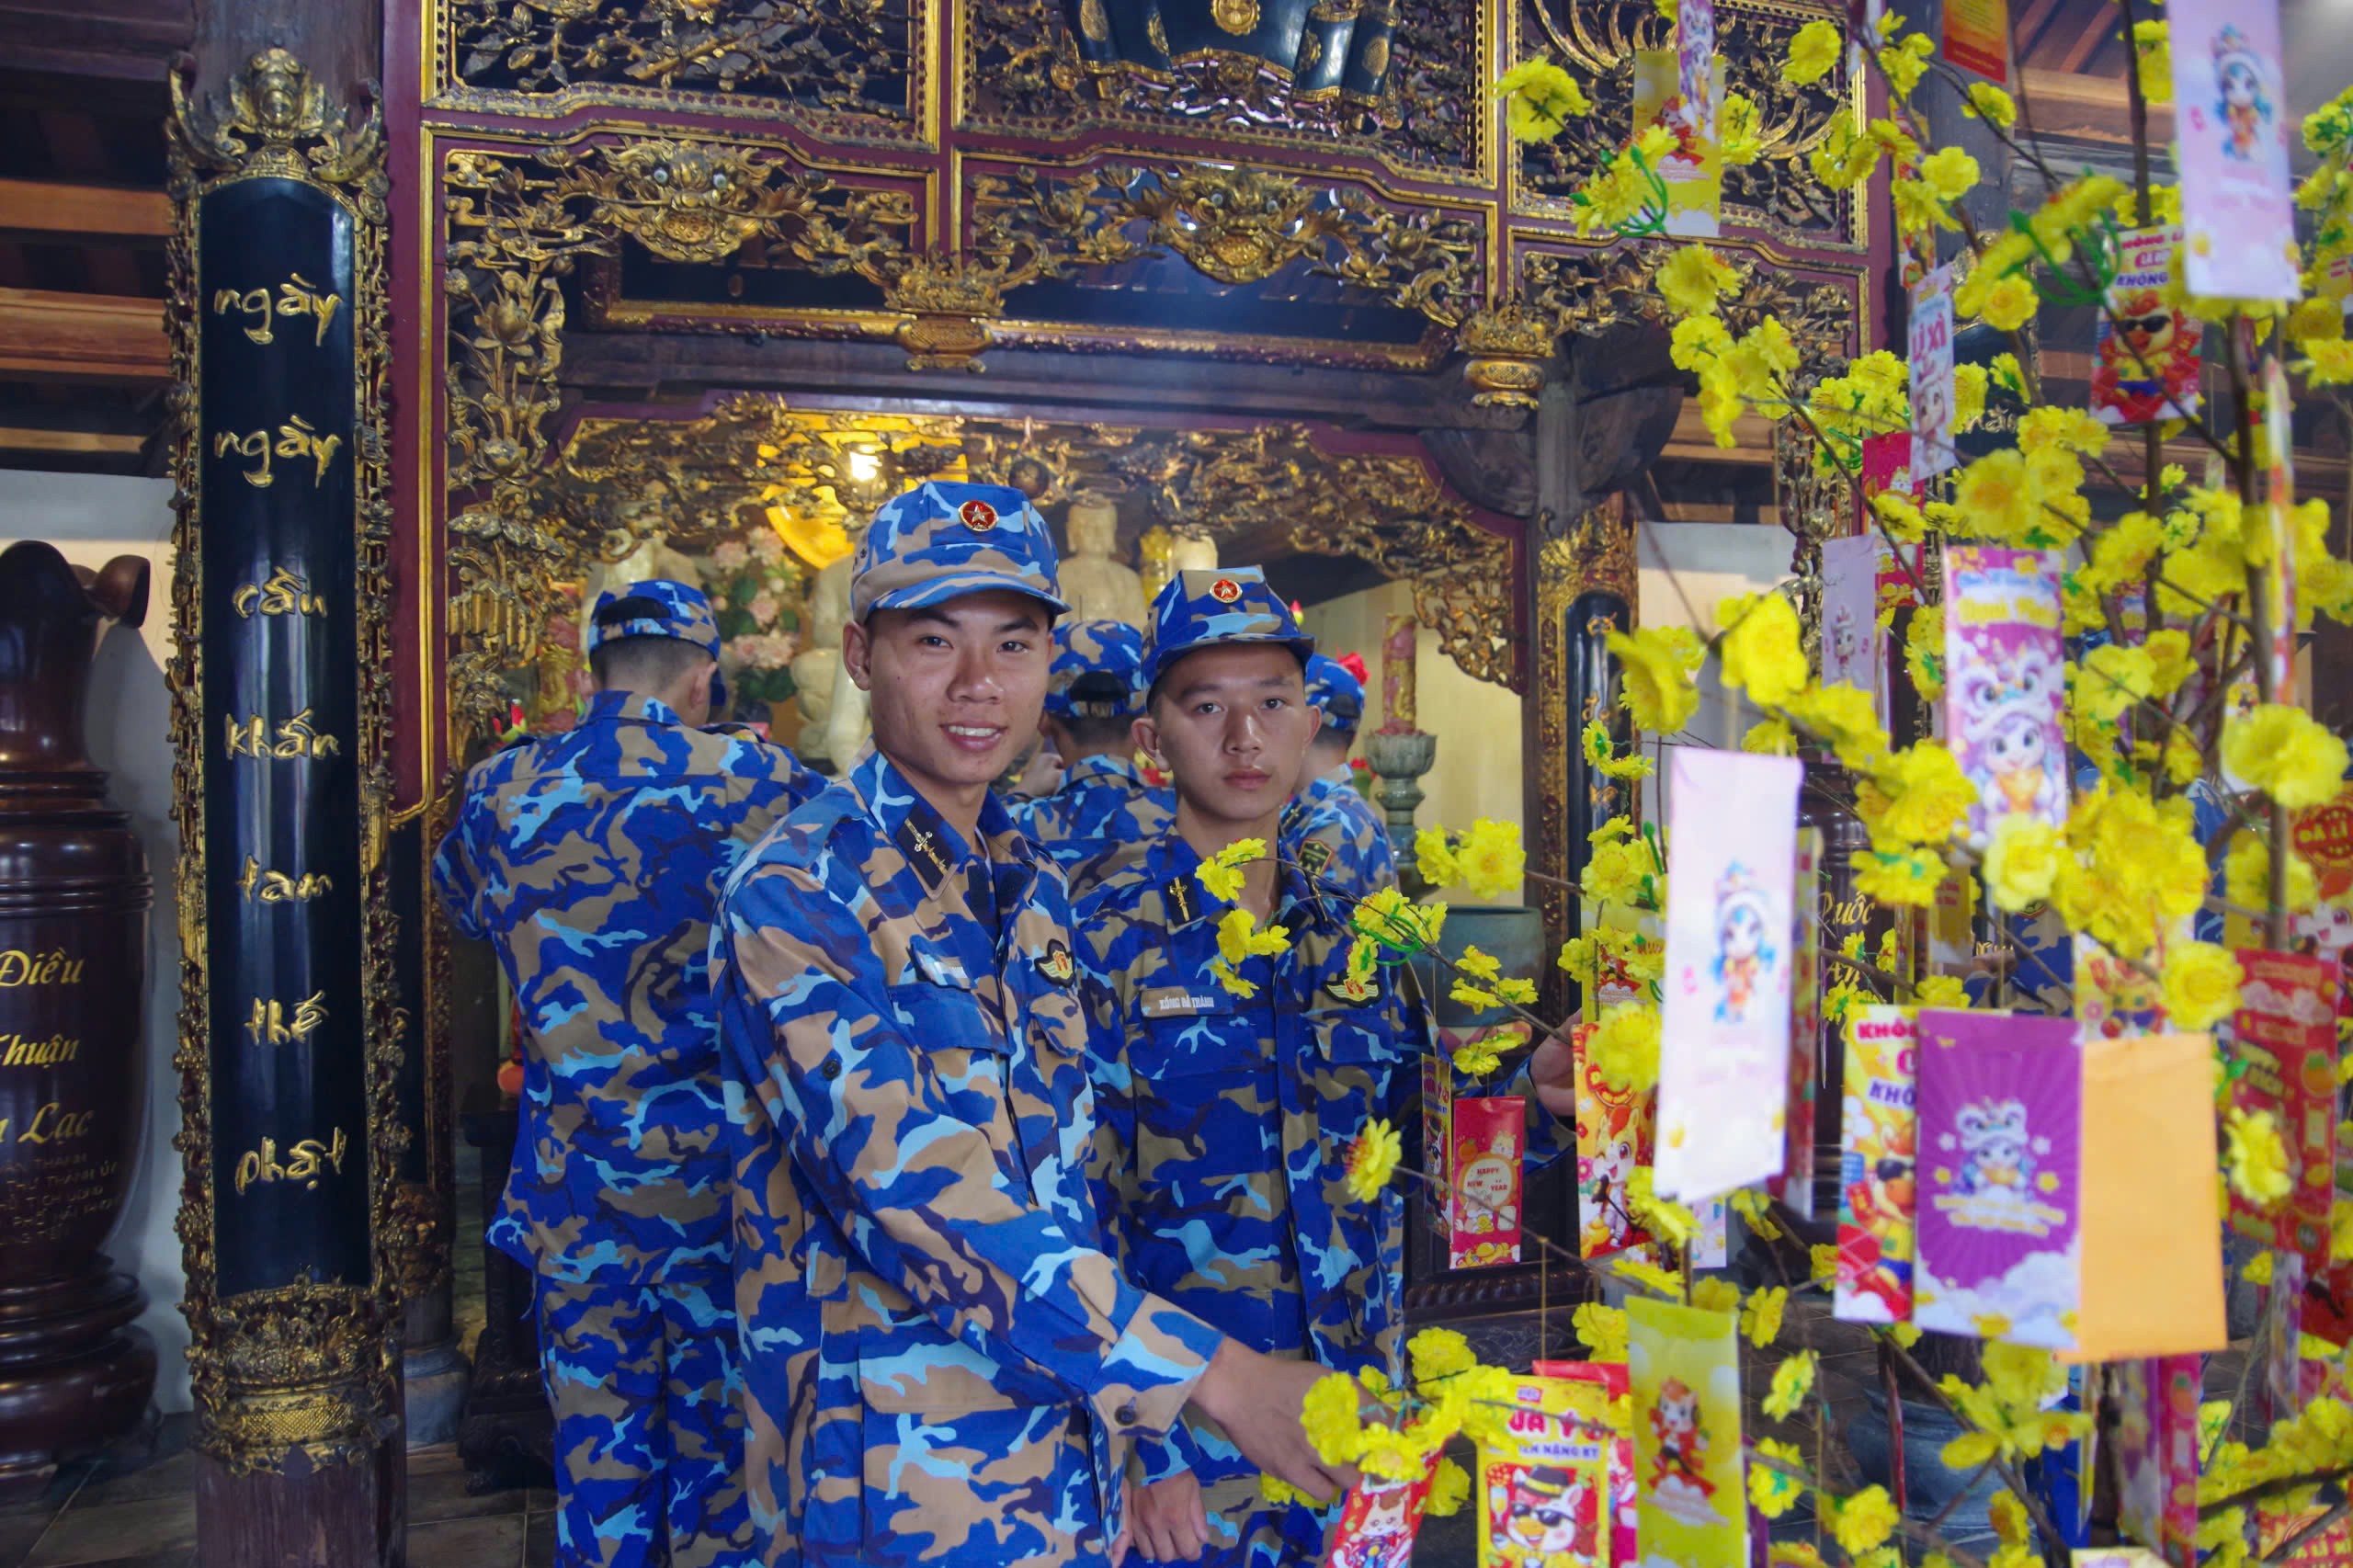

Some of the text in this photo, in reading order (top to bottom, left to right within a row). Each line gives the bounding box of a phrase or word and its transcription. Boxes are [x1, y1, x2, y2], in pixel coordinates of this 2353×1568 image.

[213, 272, 344, 347] ngày
[213, 414, 342, 488] ngày
[224, 708, 340, 760] khấn
[235, 855, 333, 903] tam
[0, 947, 85, 987] Điều
[244, 990, 330, 1046] thế
[17, 1102, 96, 1146] Lạc
[235, 1126, 347, 1196] phật
[1476, 1167, 1500, 1176] HAPPY
